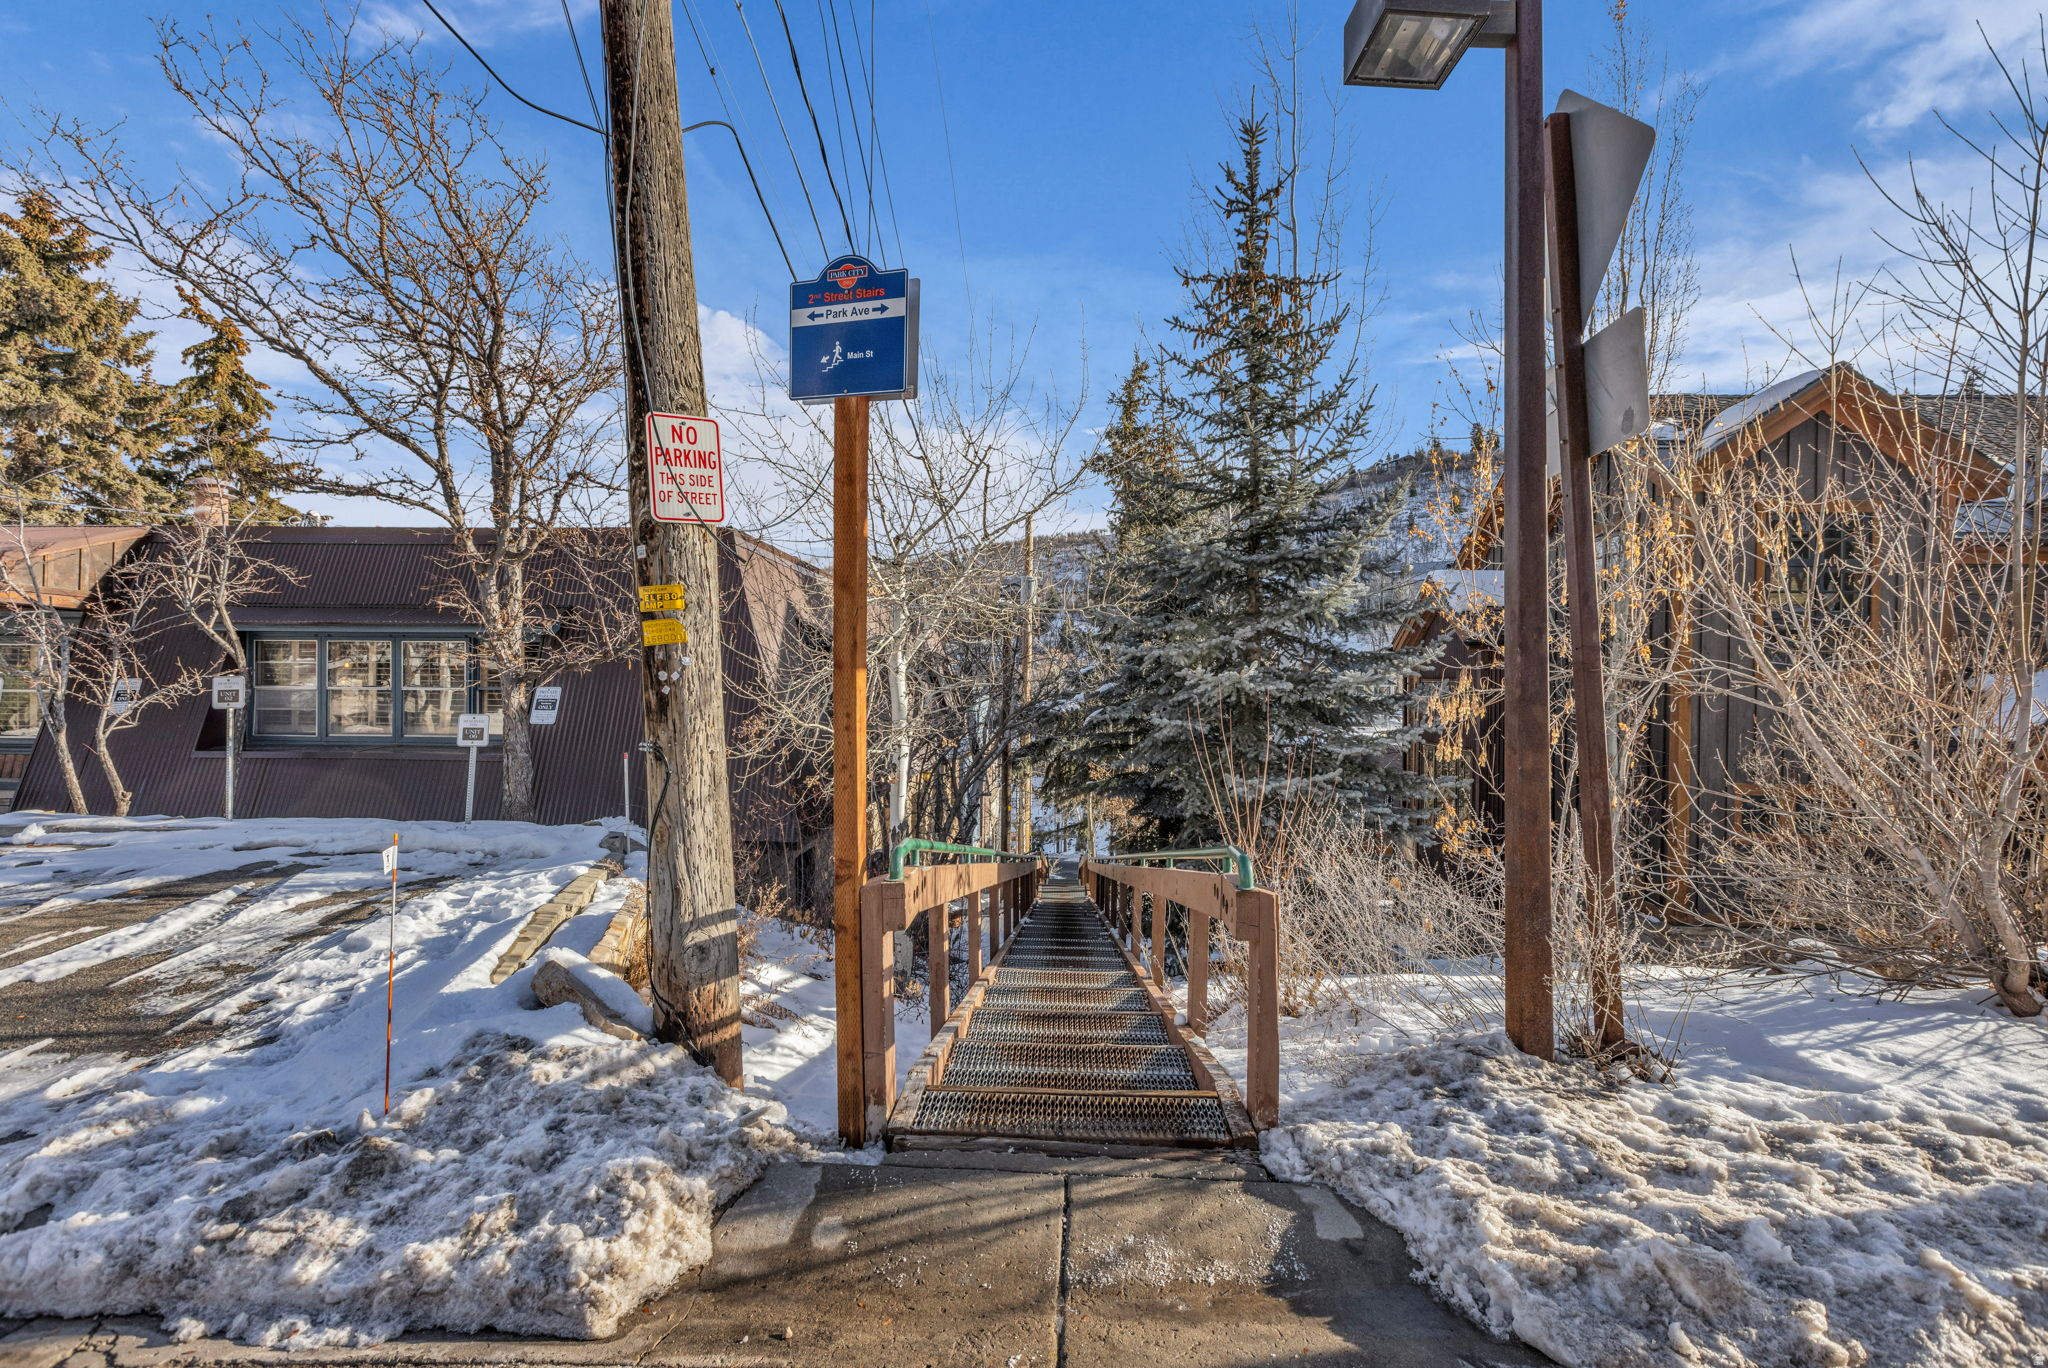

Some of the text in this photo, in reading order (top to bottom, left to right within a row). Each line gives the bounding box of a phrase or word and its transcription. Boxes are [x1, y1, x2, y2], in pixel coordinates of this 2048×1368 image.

[830, 268, 865, 279] PARK CITY
[824, 290, 853, 302] Street
[856, 288, 885, 299] Stairs
[825, 307, 870, 319] Park Ave
[847, 350, 873, 359] Main St
[671, 424, 697, 445] NO
[655, 447, 717, 470] PARKING
[659, 472, 714, 488] THIS SIDE
[659, 490, 717, 505] OF STREET
[645, 601, 663, 609] AMP
